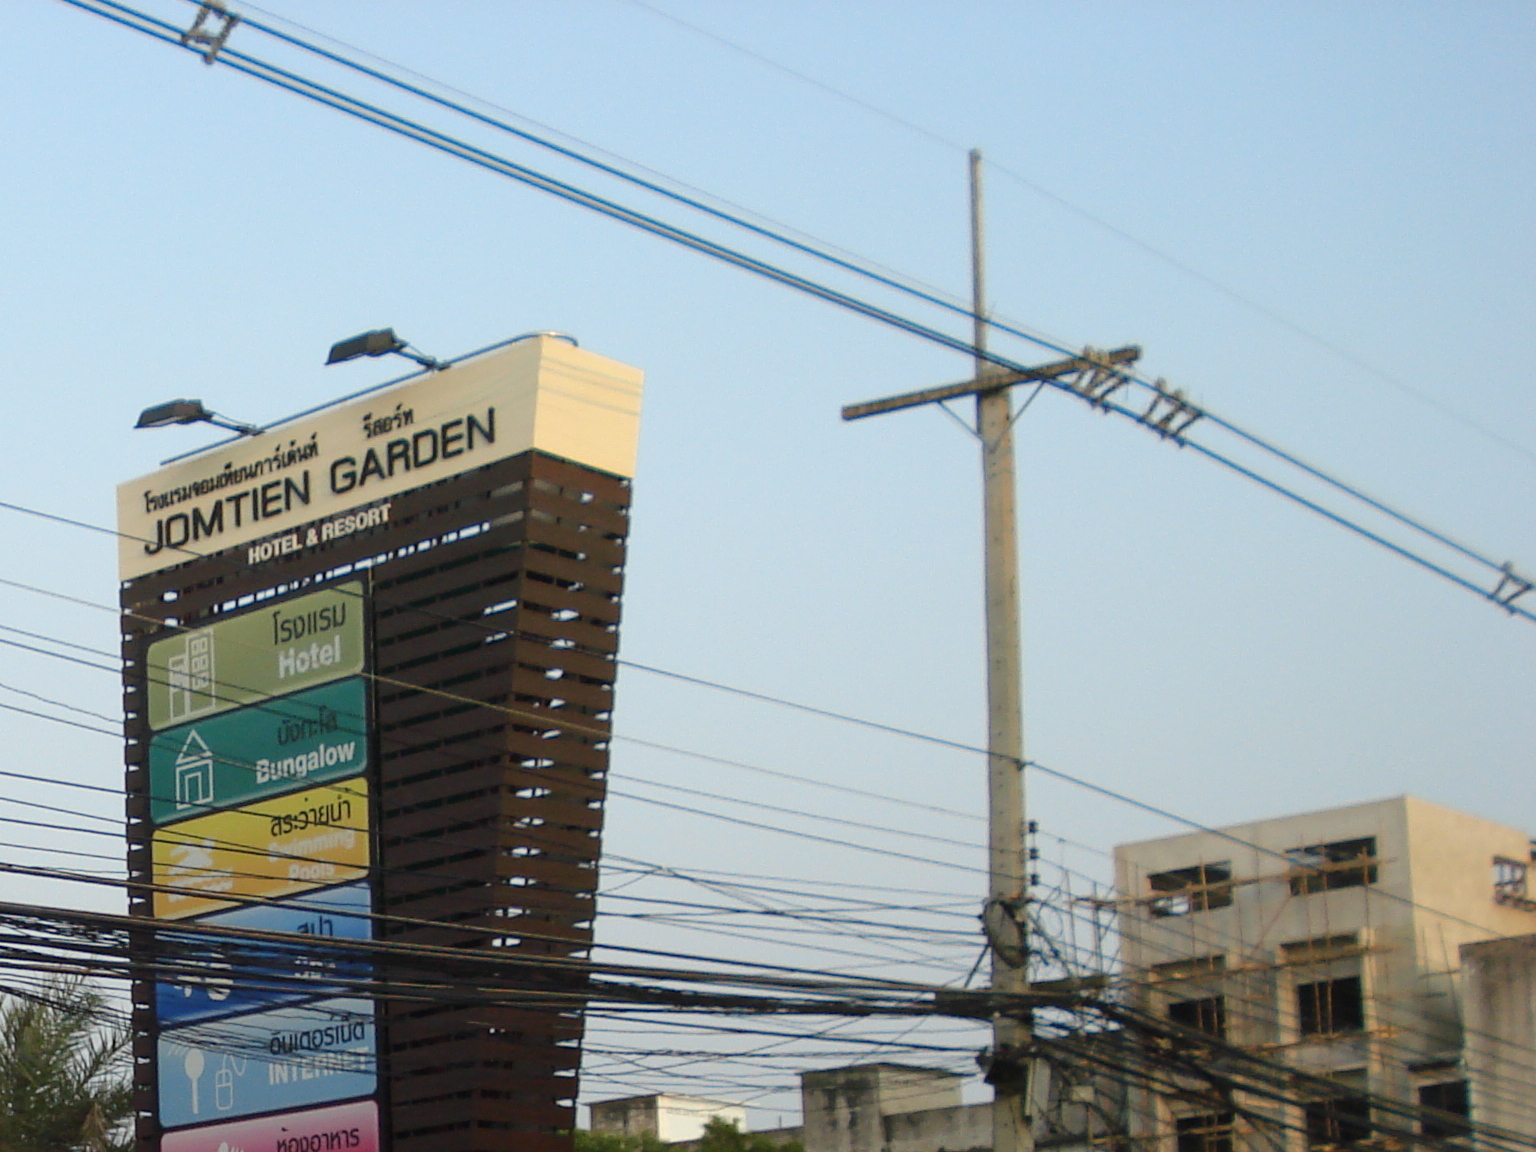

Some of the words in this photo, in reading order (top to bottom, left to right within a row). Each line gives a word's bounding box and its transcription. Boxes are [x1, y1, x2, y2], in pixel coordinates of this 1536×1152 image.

[144, 469, 311, 555] JOMTIEN
[330, 406, 496, 494] GARDEN
[247, 533, 303, 565] HOTEL
[306, 527, 319, 547] &
[321, 502, 392, 542] RESORT
[272, 602, 346, 645] โรงแรม
[277, 634, 341, 679] Hotel
[255, 741, 356, 783] Bungalow
